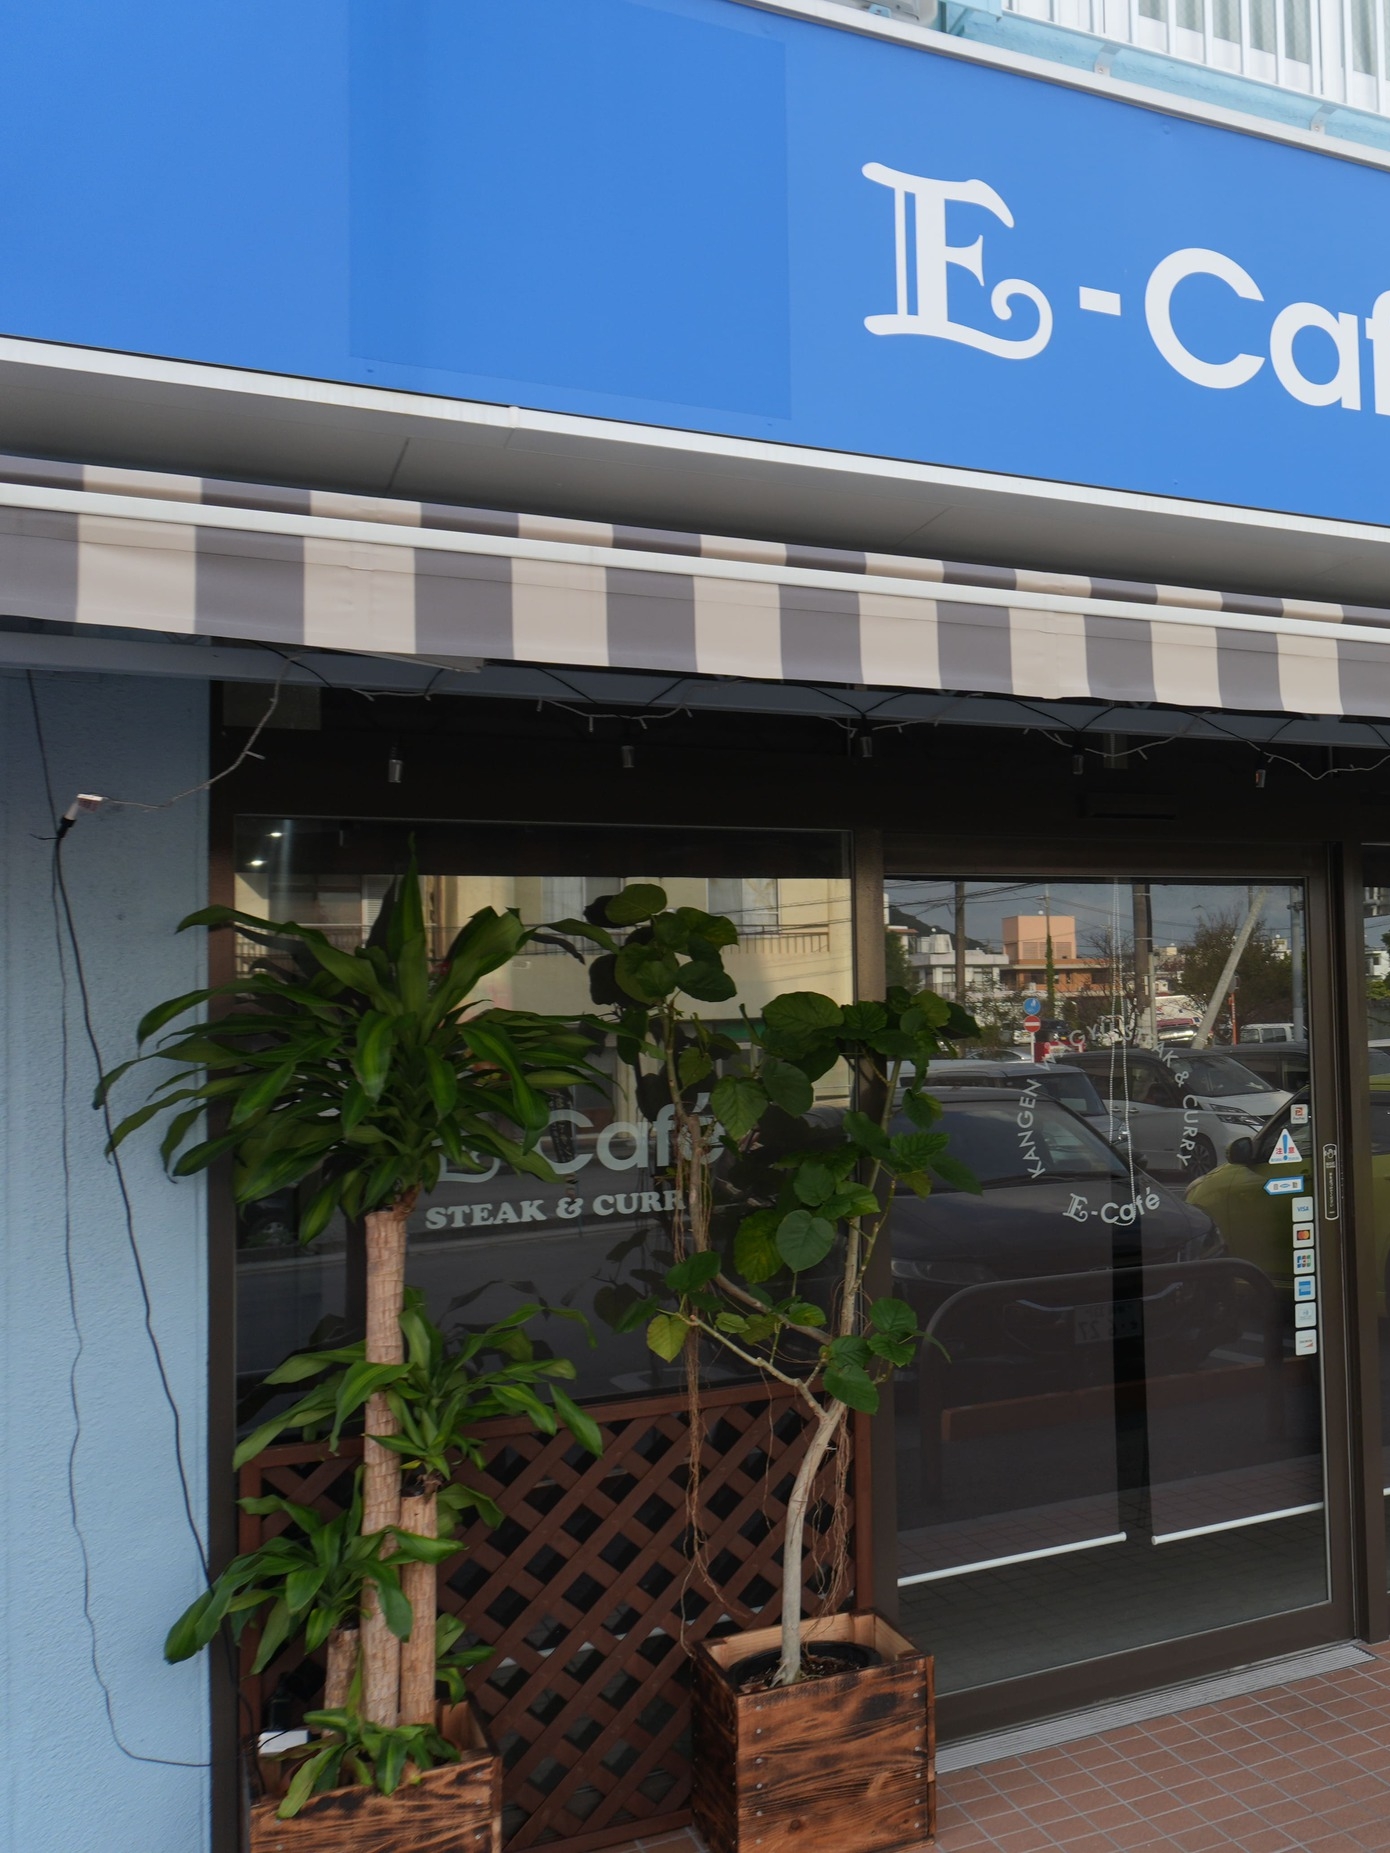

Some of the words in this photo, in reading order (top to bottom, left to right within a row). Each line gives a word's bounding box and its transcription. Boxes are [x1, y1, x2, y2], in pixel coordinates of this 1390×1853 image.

[1017, 1079, 1045, 1178] KANGEN
[1177, 1094, 1198, 1167] CURRY
[425, 1199, 547, 1229] STEAK
[555, 1196, 583, 1218] &
[592, 1190, 687, 1216] CURR
[1062, 1187, 1160, 1224] E-Café
